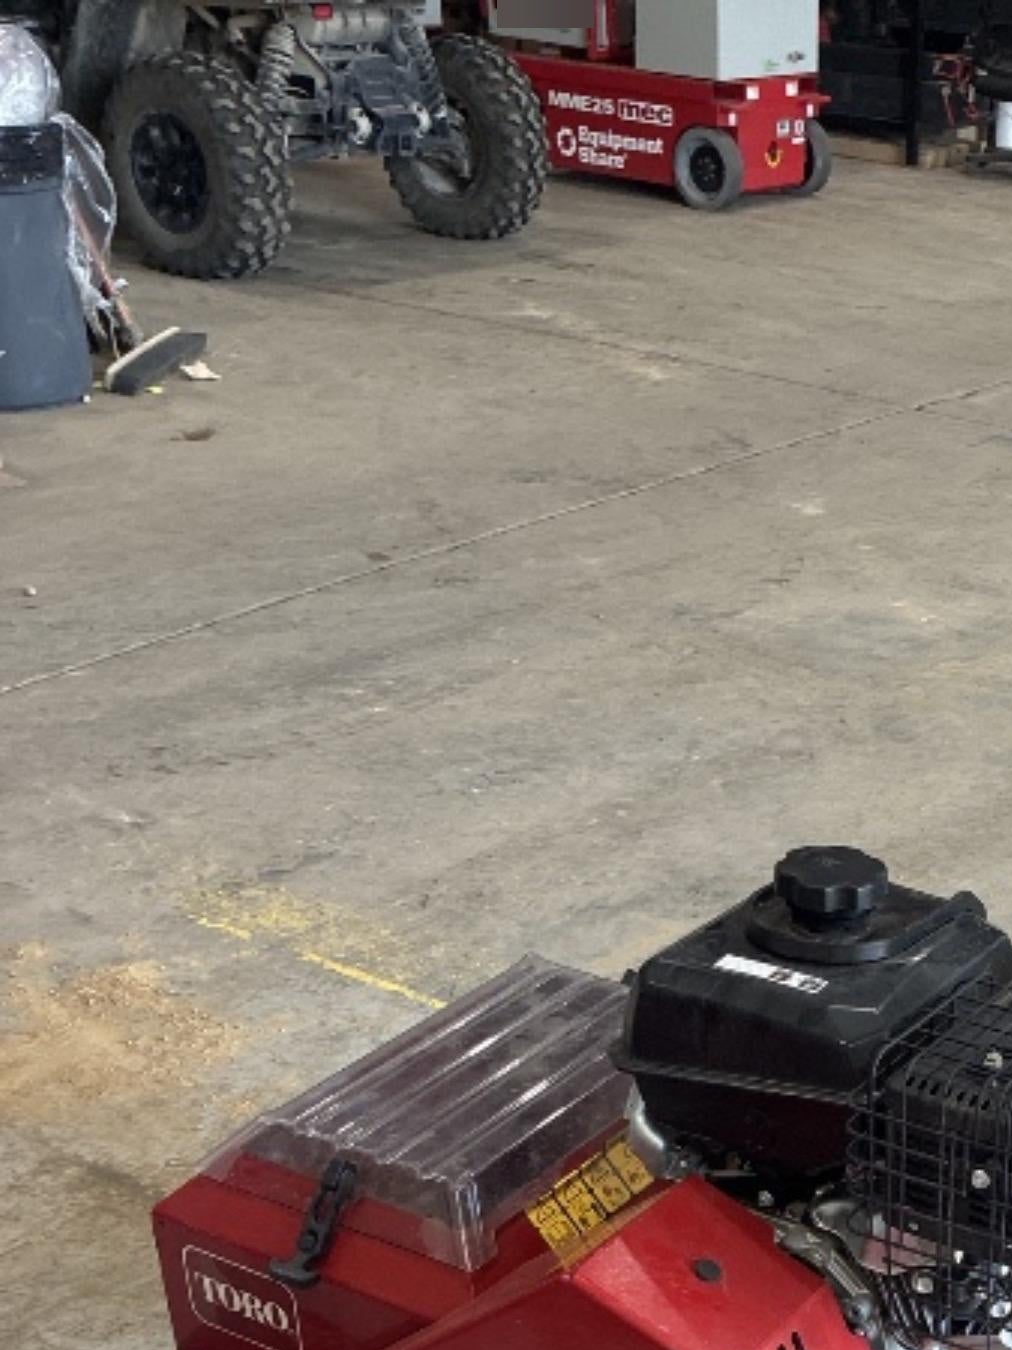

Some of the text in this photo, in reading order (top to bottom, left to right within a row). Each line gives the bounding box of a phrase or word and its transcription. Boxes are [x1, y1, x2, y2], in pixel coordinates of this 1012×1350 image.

[577, 125, 664, 154] Equipment
[578, 146, 625, 169] Share
[193, 1271, 290, 1331] TORO
